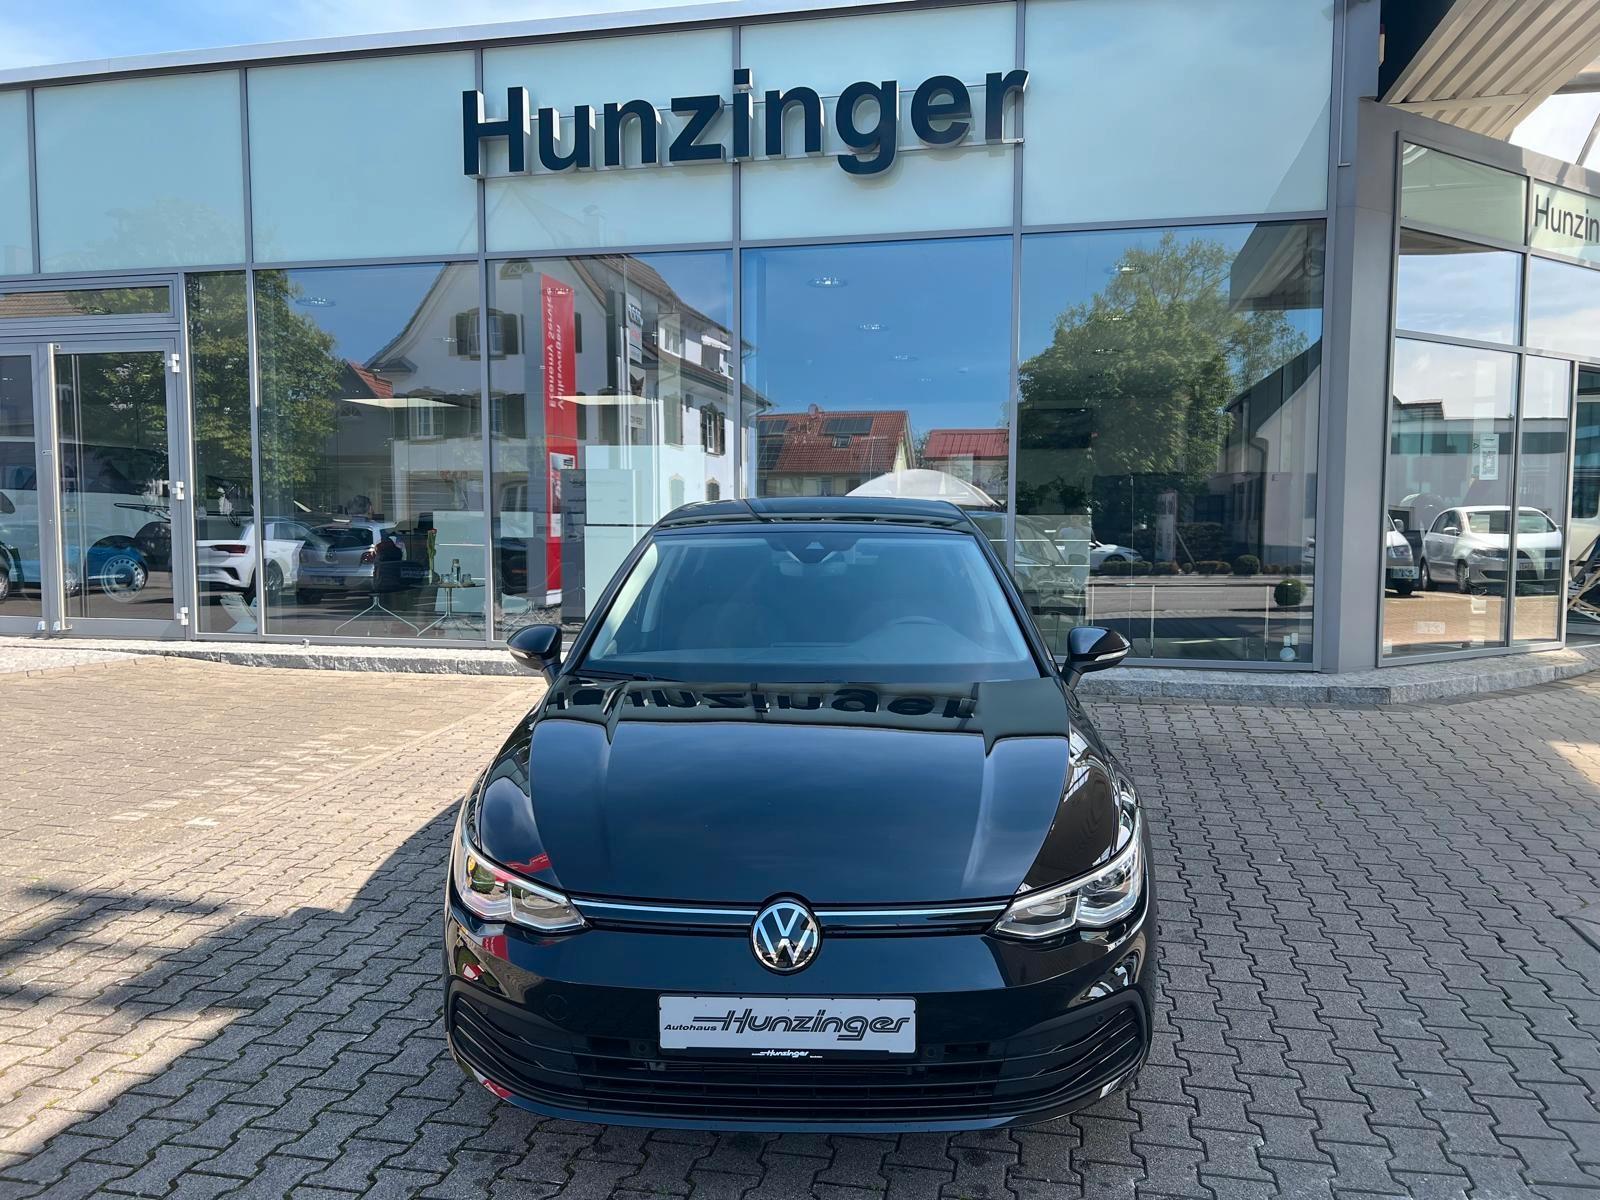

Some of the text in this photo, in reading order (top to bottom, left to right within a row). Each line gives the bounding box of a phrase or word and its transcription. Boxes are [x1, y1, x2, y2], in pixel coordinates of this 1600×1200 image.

[462, 68, 1029, 176] Hunzinger
[1534, 193, 1600, 243] Hunzin
[692, 1008, 910, 1041] Hunzinger
[759, 1049, 809, 1058] Hunzinger
